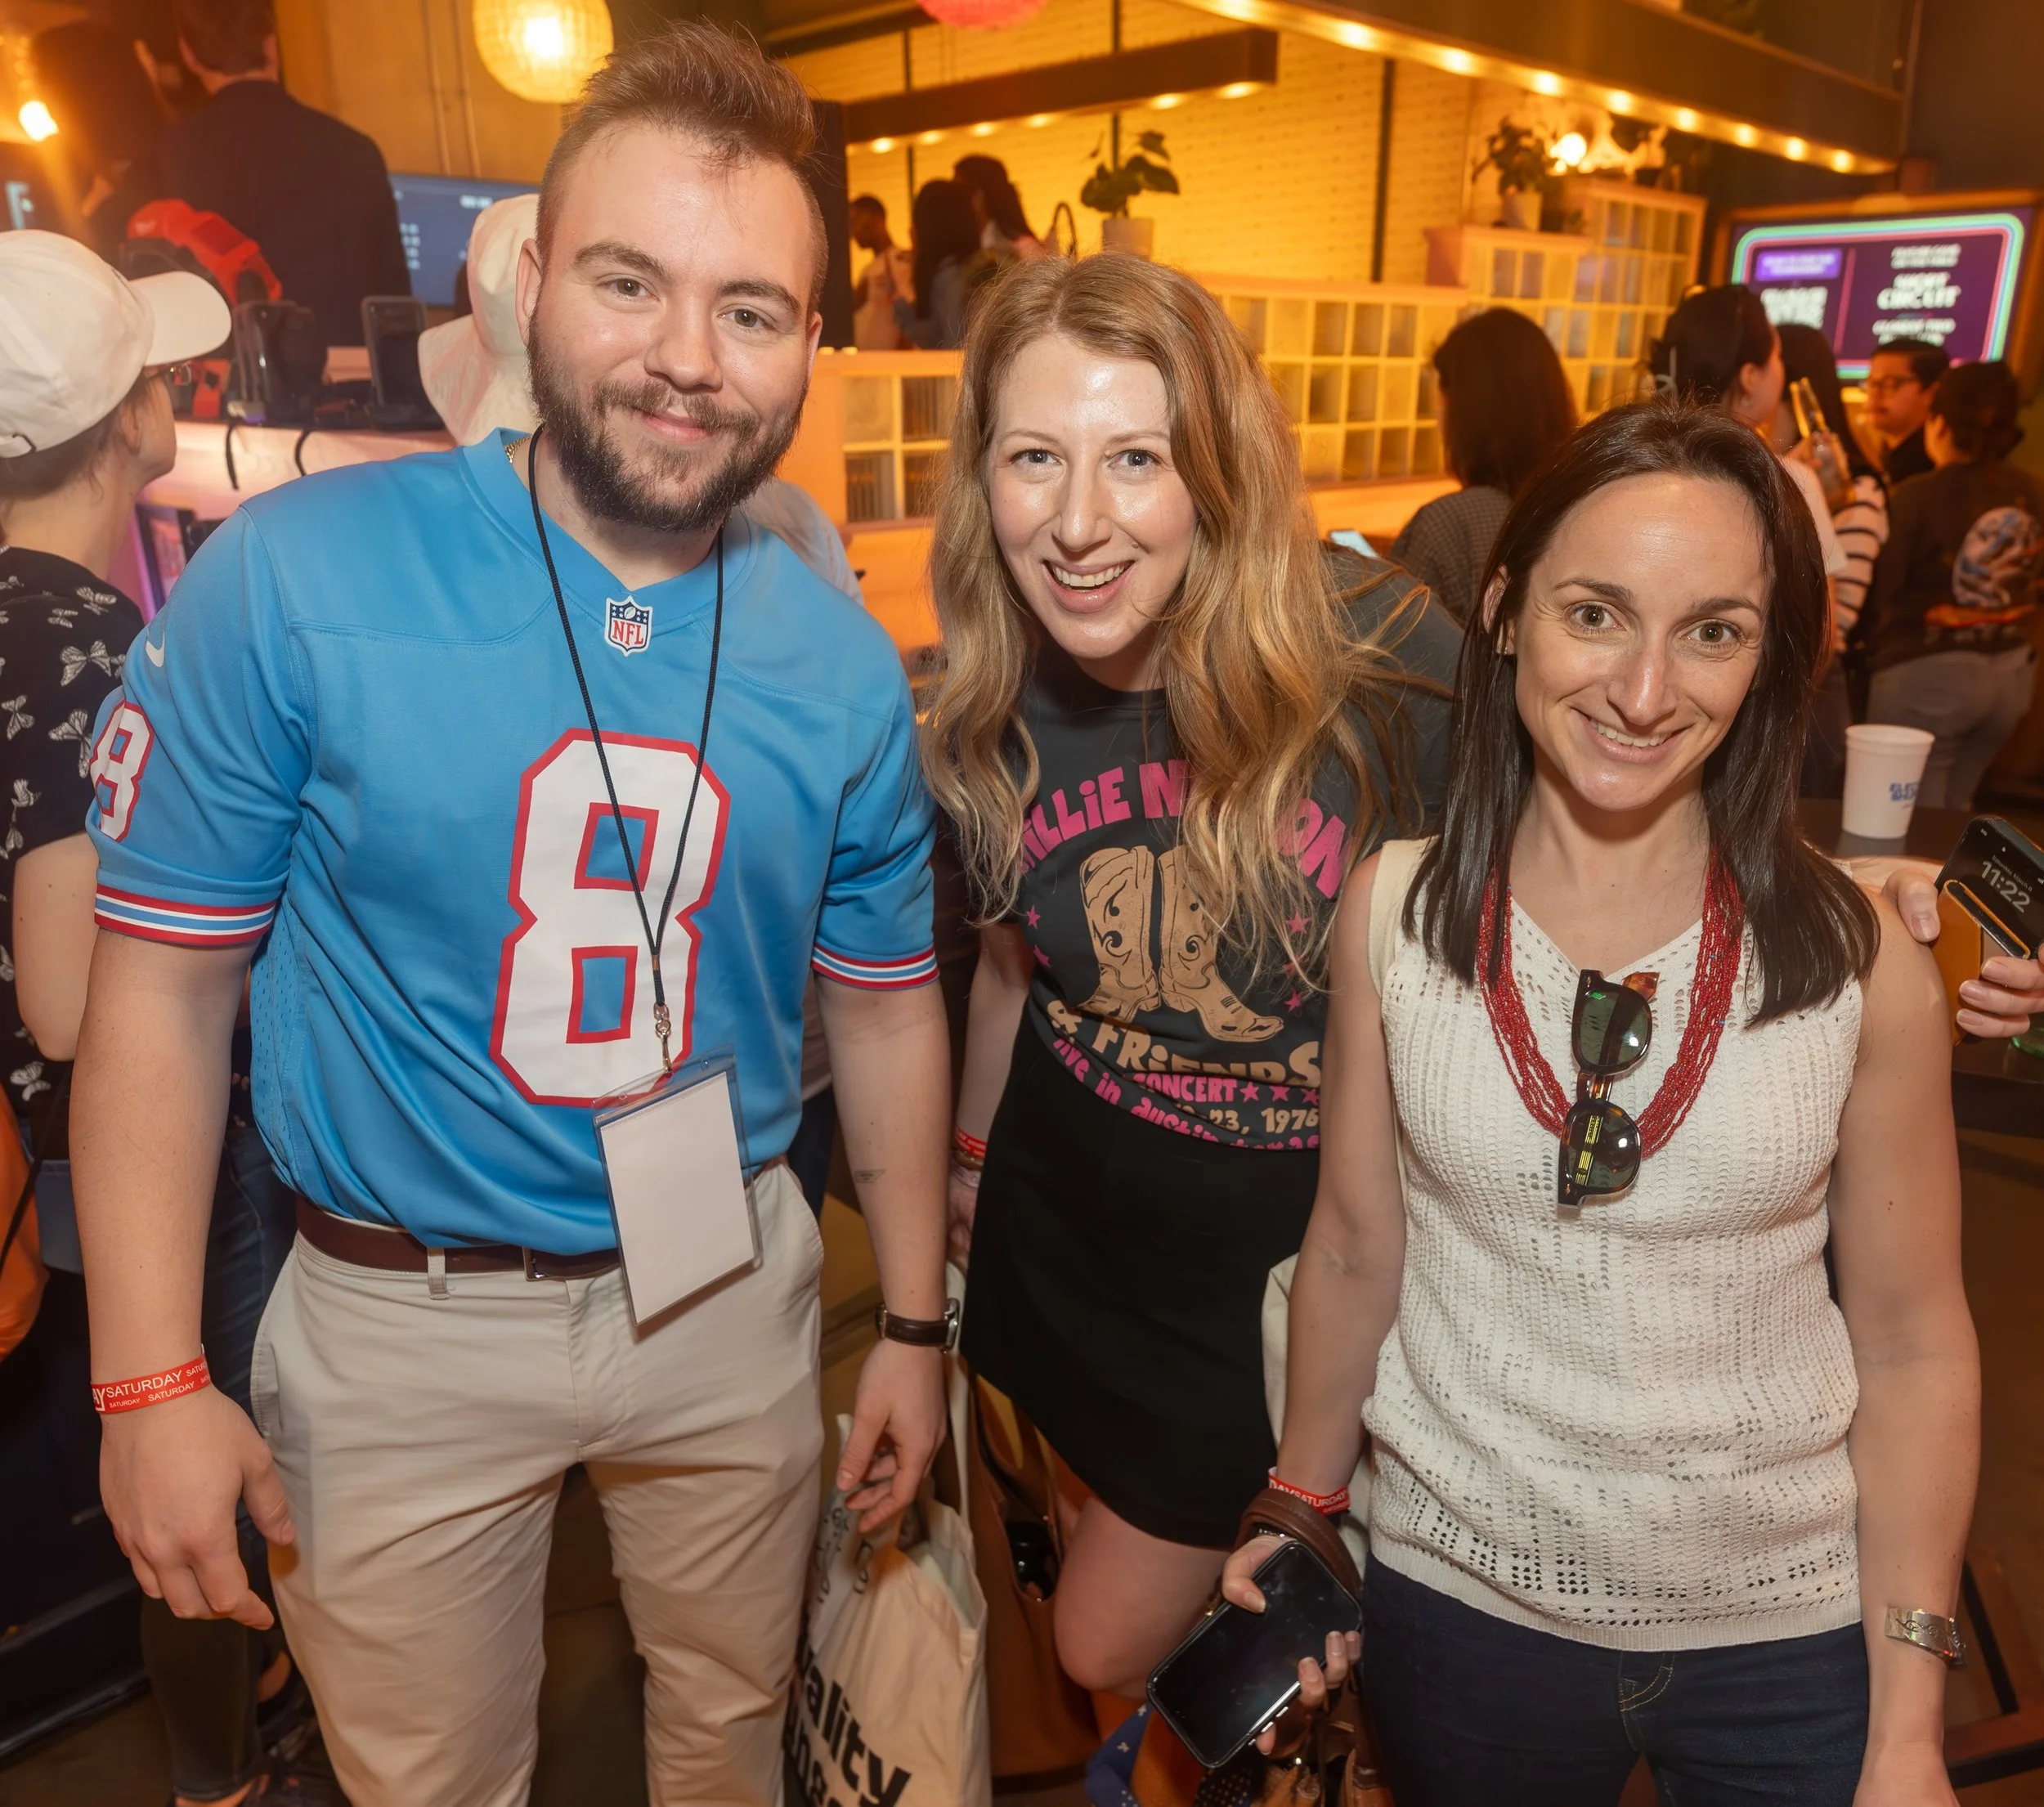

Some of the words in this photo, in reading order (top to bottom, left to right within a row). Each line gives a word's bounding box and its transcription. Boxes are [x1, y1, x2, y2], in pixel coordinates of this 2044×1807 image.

[612, 619, 644, 646] NFL
[88, 698, 155, 844] 8
[1981, 860, 2031, 913] 11:22
[488, 727, 732, 1109] 8
[1261, 1107, 1320, 1135] 1976
[105, 1370, 182, 1398] SATURDAY
[109, 1397, 141, 1409] SATURDAY
[147, 1381, 195, 1402] SATURDAY
